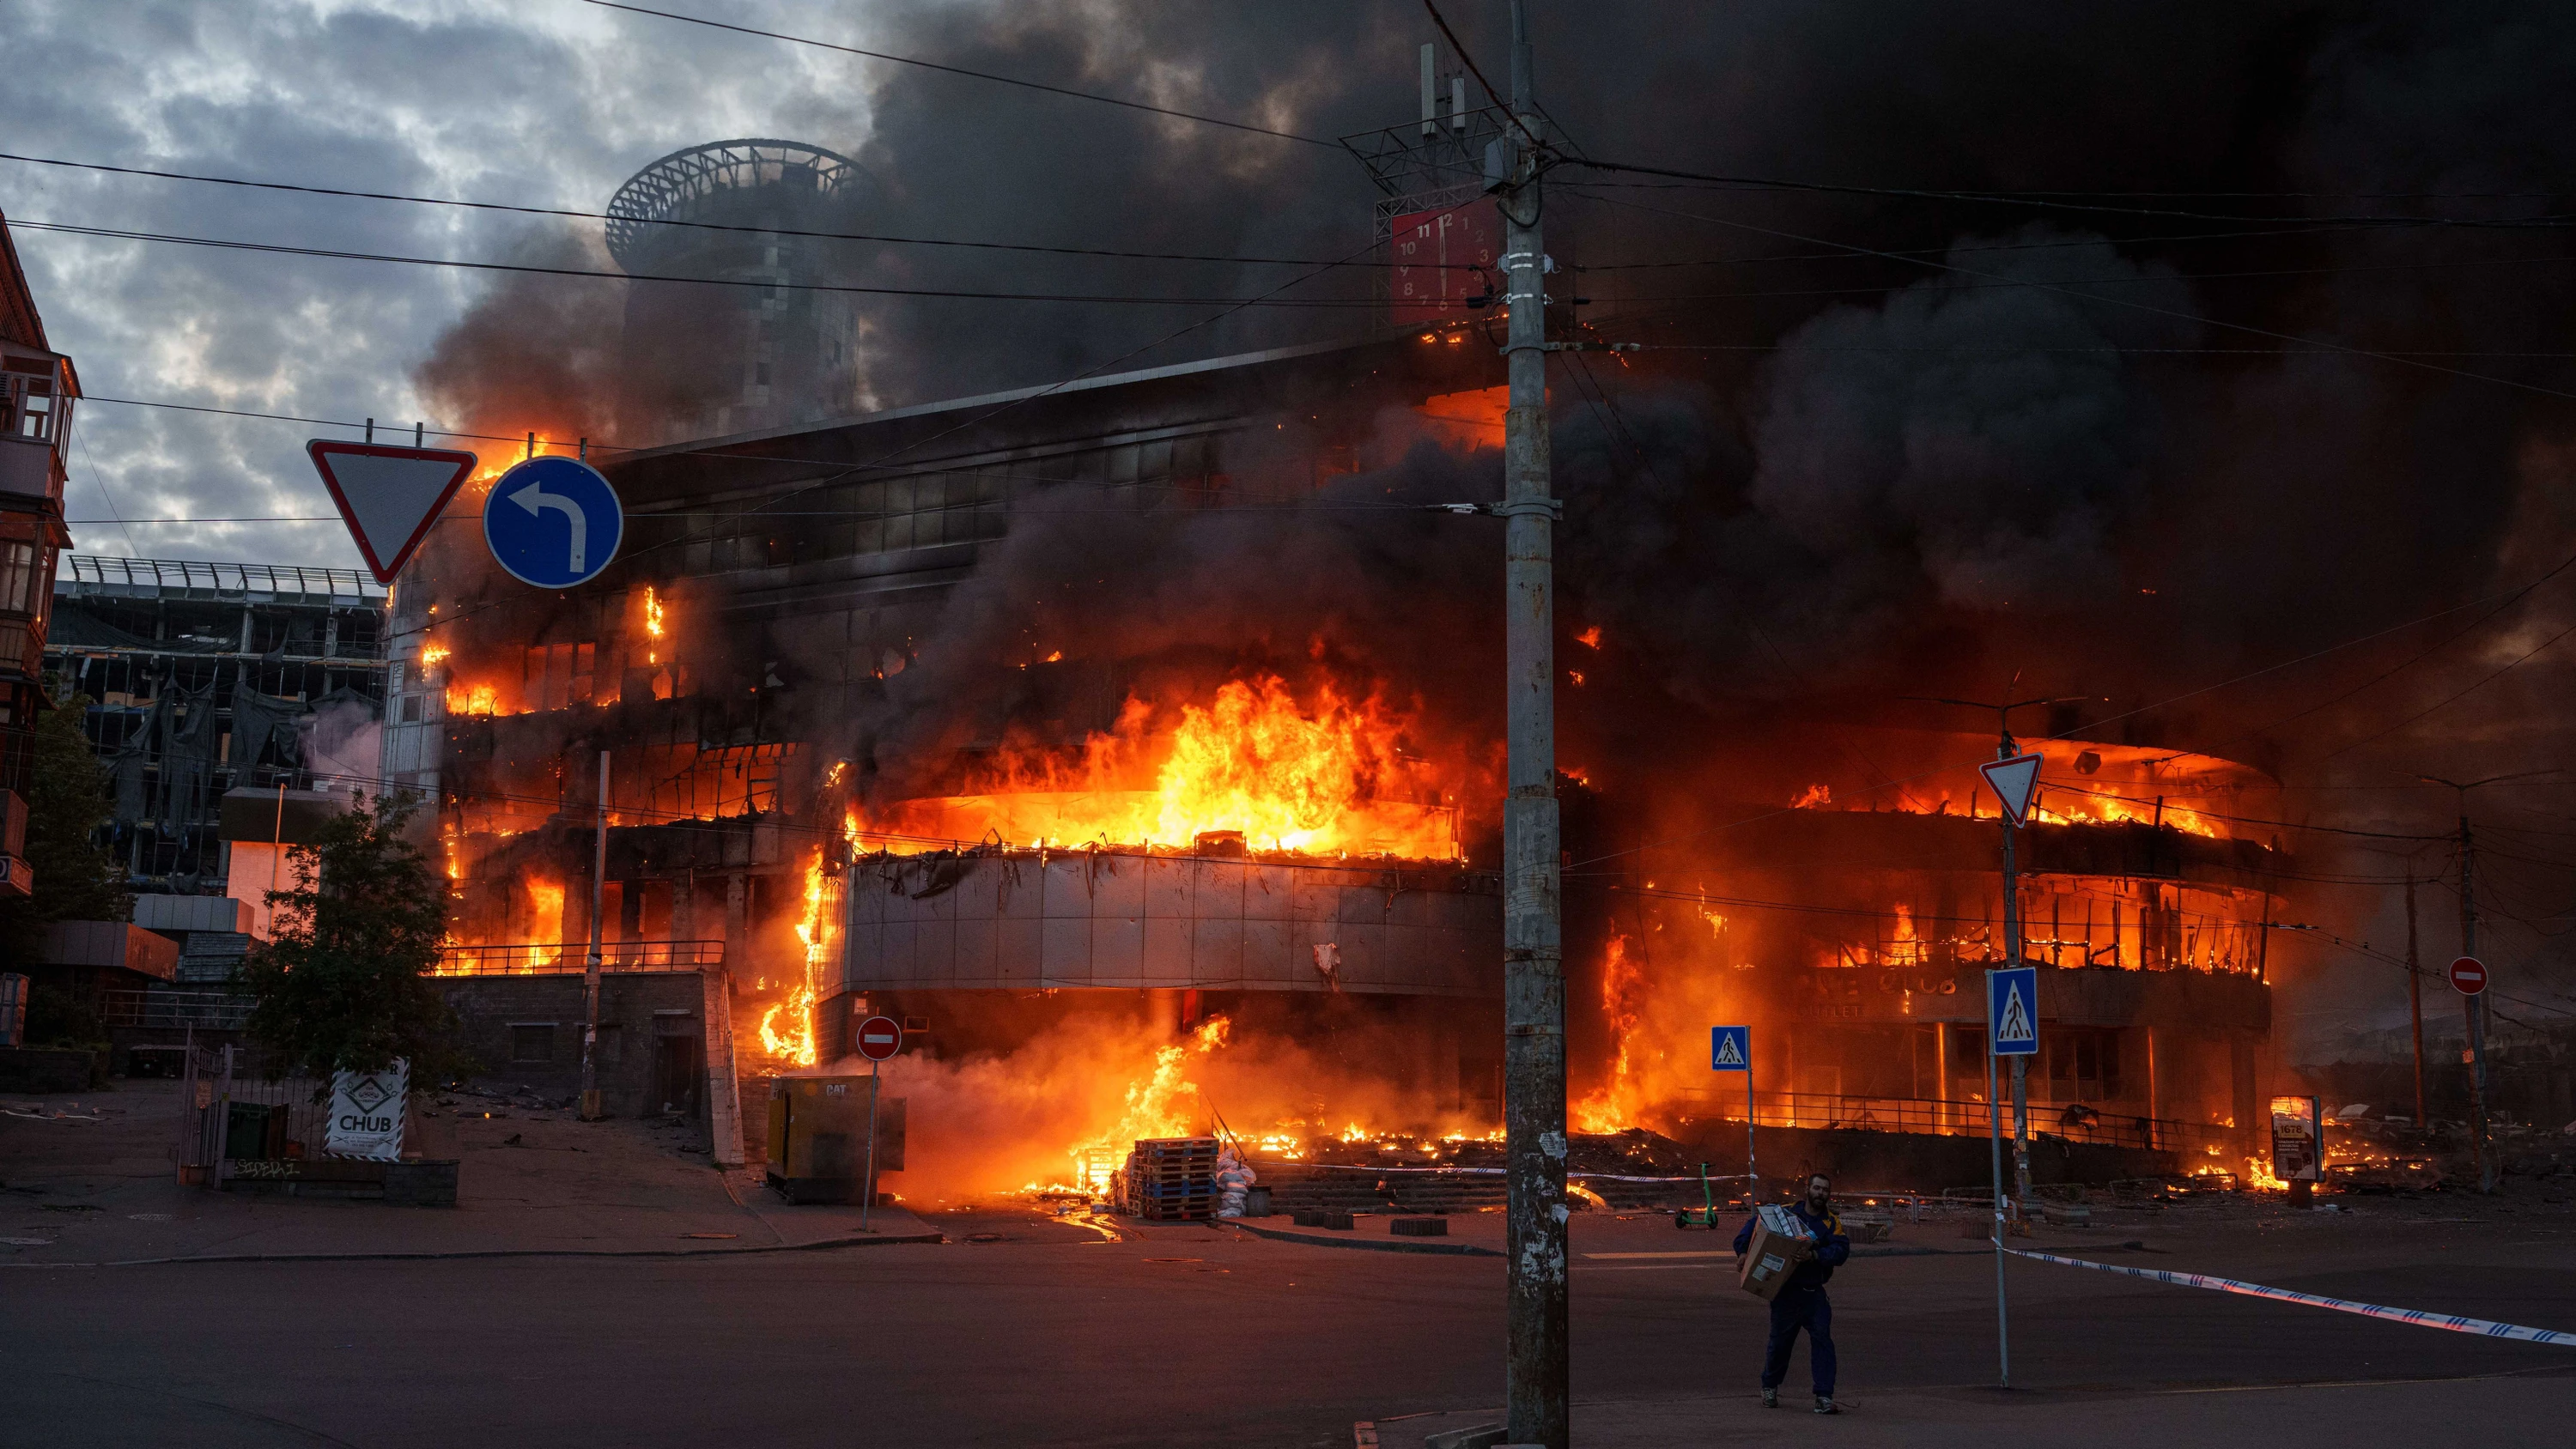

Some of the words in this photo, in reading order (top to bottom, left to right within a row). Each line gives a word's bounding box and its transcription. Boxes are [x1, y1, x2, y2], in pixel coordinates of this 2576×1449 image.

[1437, 213, 1453, 228] 12
[1462, 216, 1468, 230] 1
[1417, 224, 1431, 239] 11
[1475, 229, 1484, 242] 2
[1400, 241, 1416, 256] 10
[1479, 249, 1489, 262] 3
[1400, 264, 1409, 276] 9
[1404, 282, 1413, 296] 8
[1460, 288, 1467, 300] 5
[1419, 294, 1429, 306] 7
[1438, 297, 1449, 311] 6
[826, 1084, 847, 1097] CAT
[339, 1115, 392, 1132] CHUB
[2281, 1125, 2302, 1134] 1678
